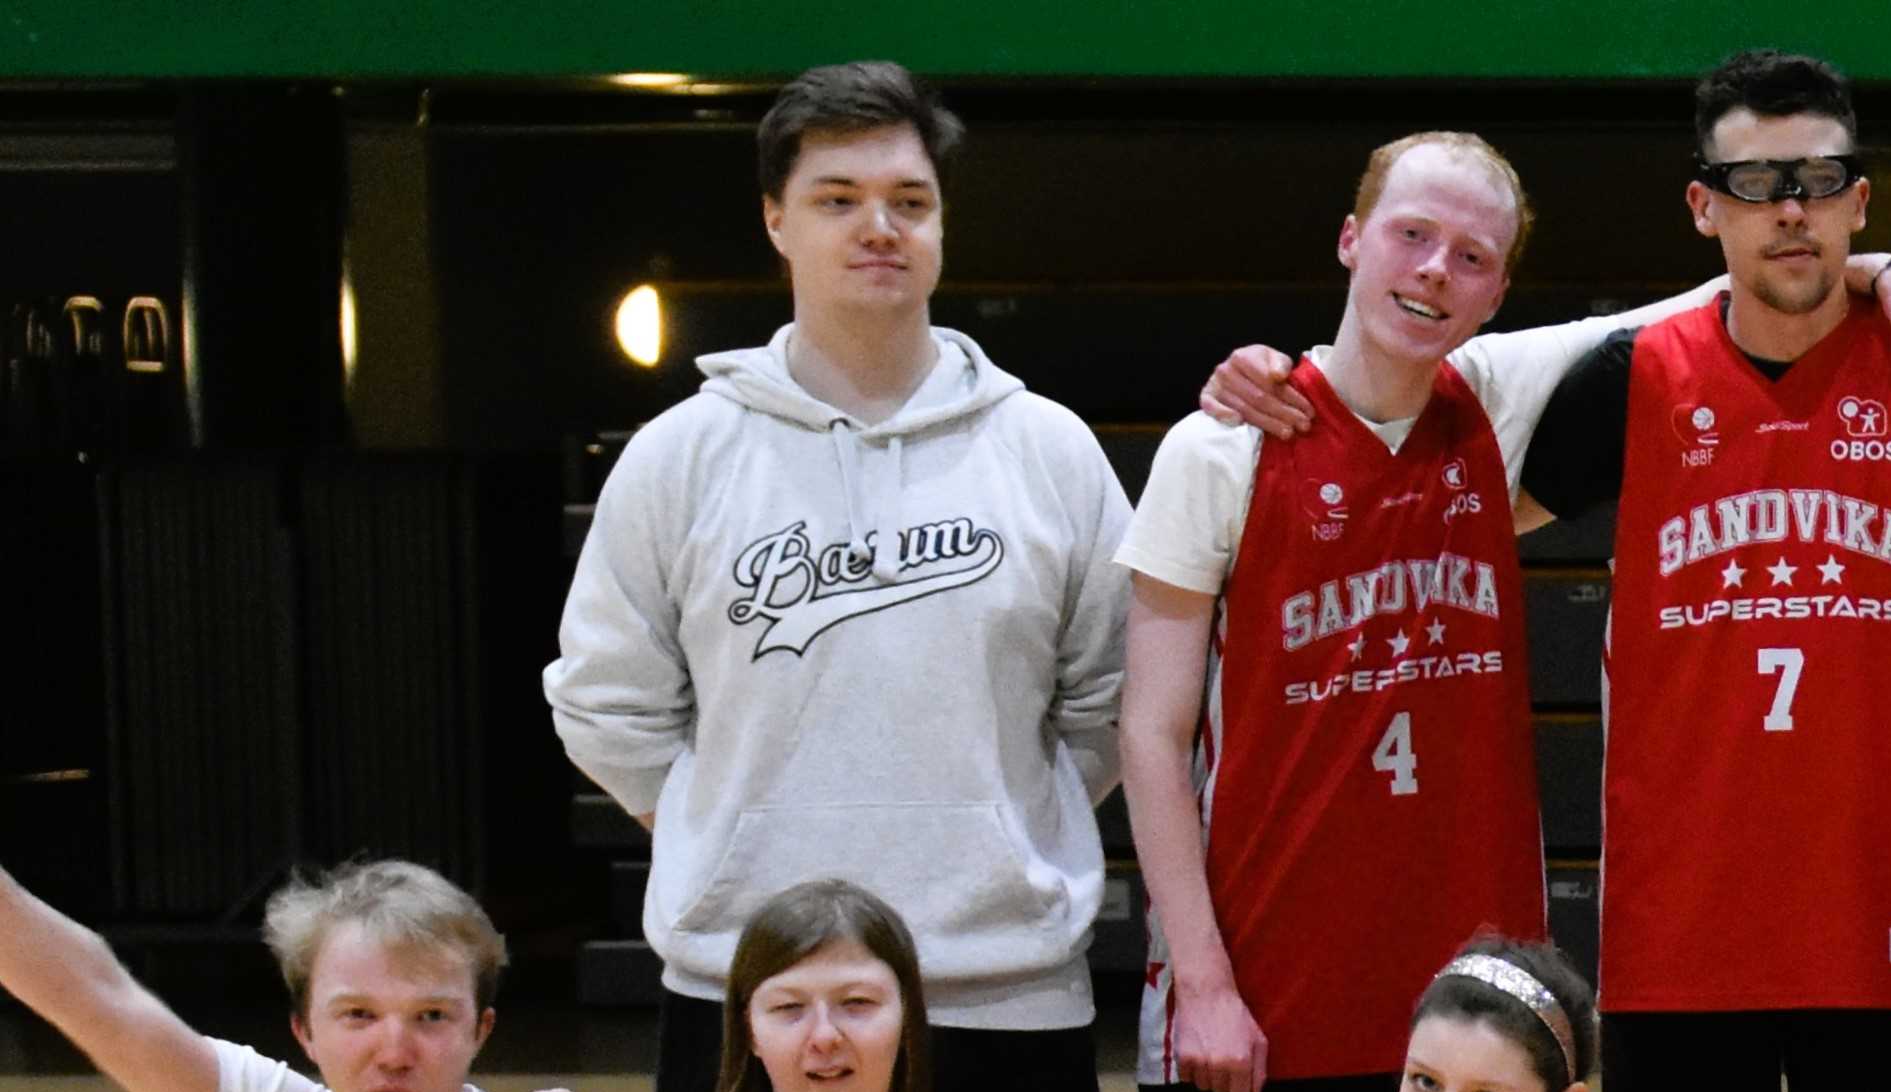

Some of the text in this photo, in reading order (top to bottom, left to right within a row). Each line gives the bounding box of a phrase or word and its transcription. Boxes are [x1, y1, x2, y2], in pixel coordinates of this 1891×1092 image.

[1681, 449, 1715, 467] NBBF
[728, 517, 1003, 640] Bæum
[1757, 648, 1805, 732] 7
[1371, 711, 1419, 796] 4
